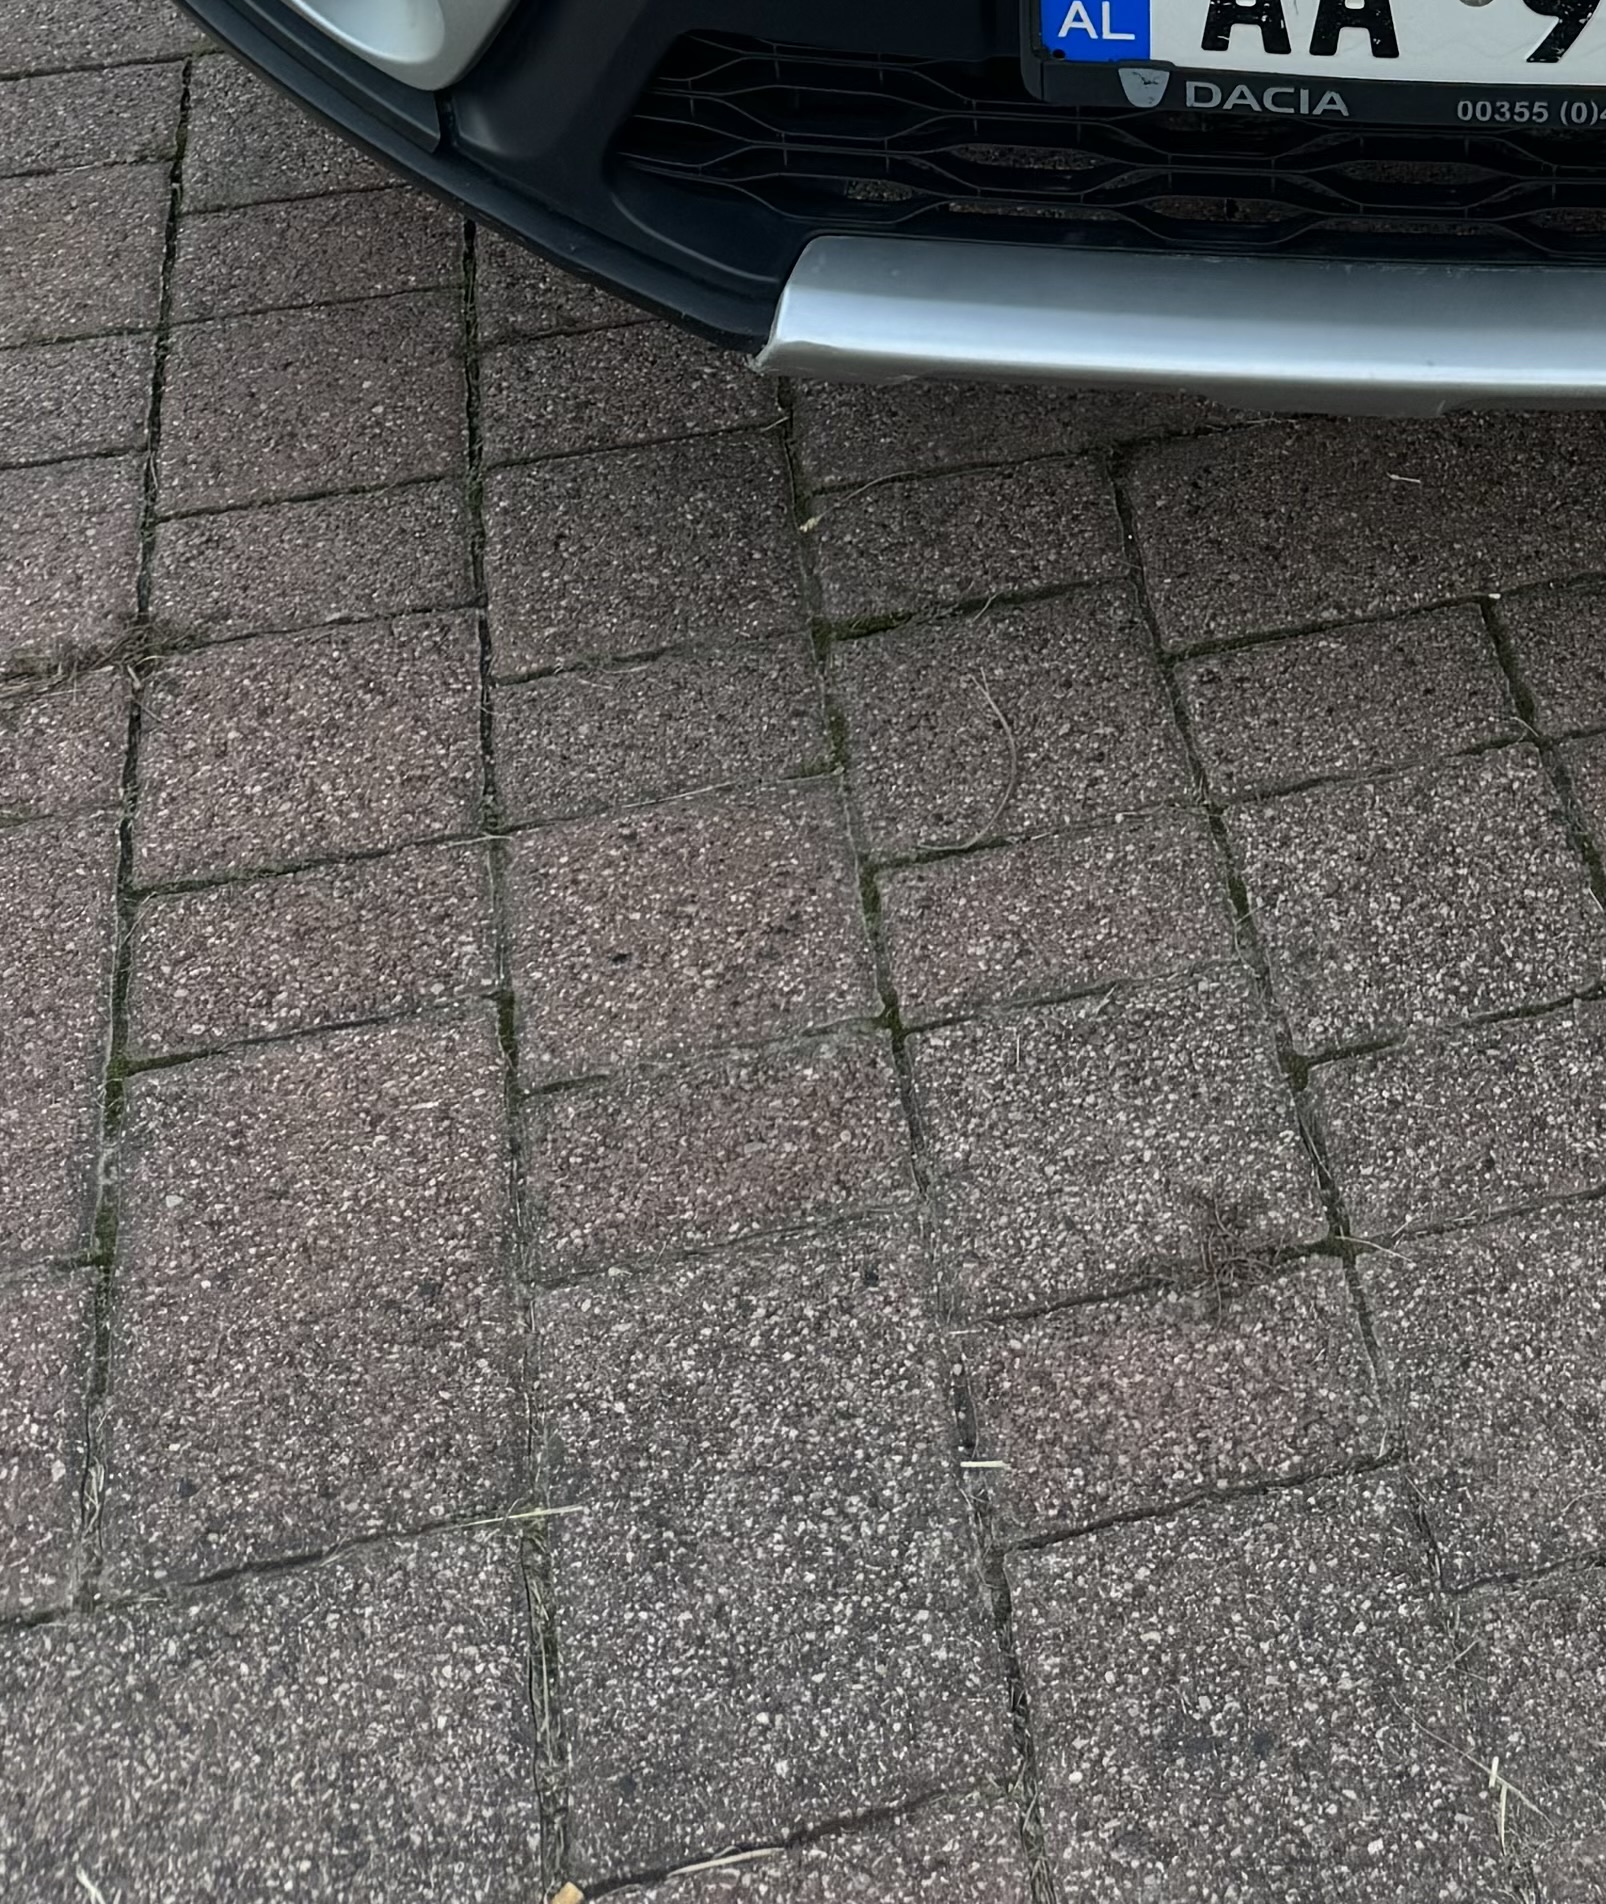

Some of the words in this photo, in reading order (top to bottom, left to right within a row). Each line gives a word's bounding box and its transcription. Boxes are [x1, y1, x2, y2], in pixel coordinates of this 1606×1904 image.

[1058, 0, 1136, 41] AL
[1185, 81, 1350, 117] DACIA
[1457, 100, 1549, 124] 00355
